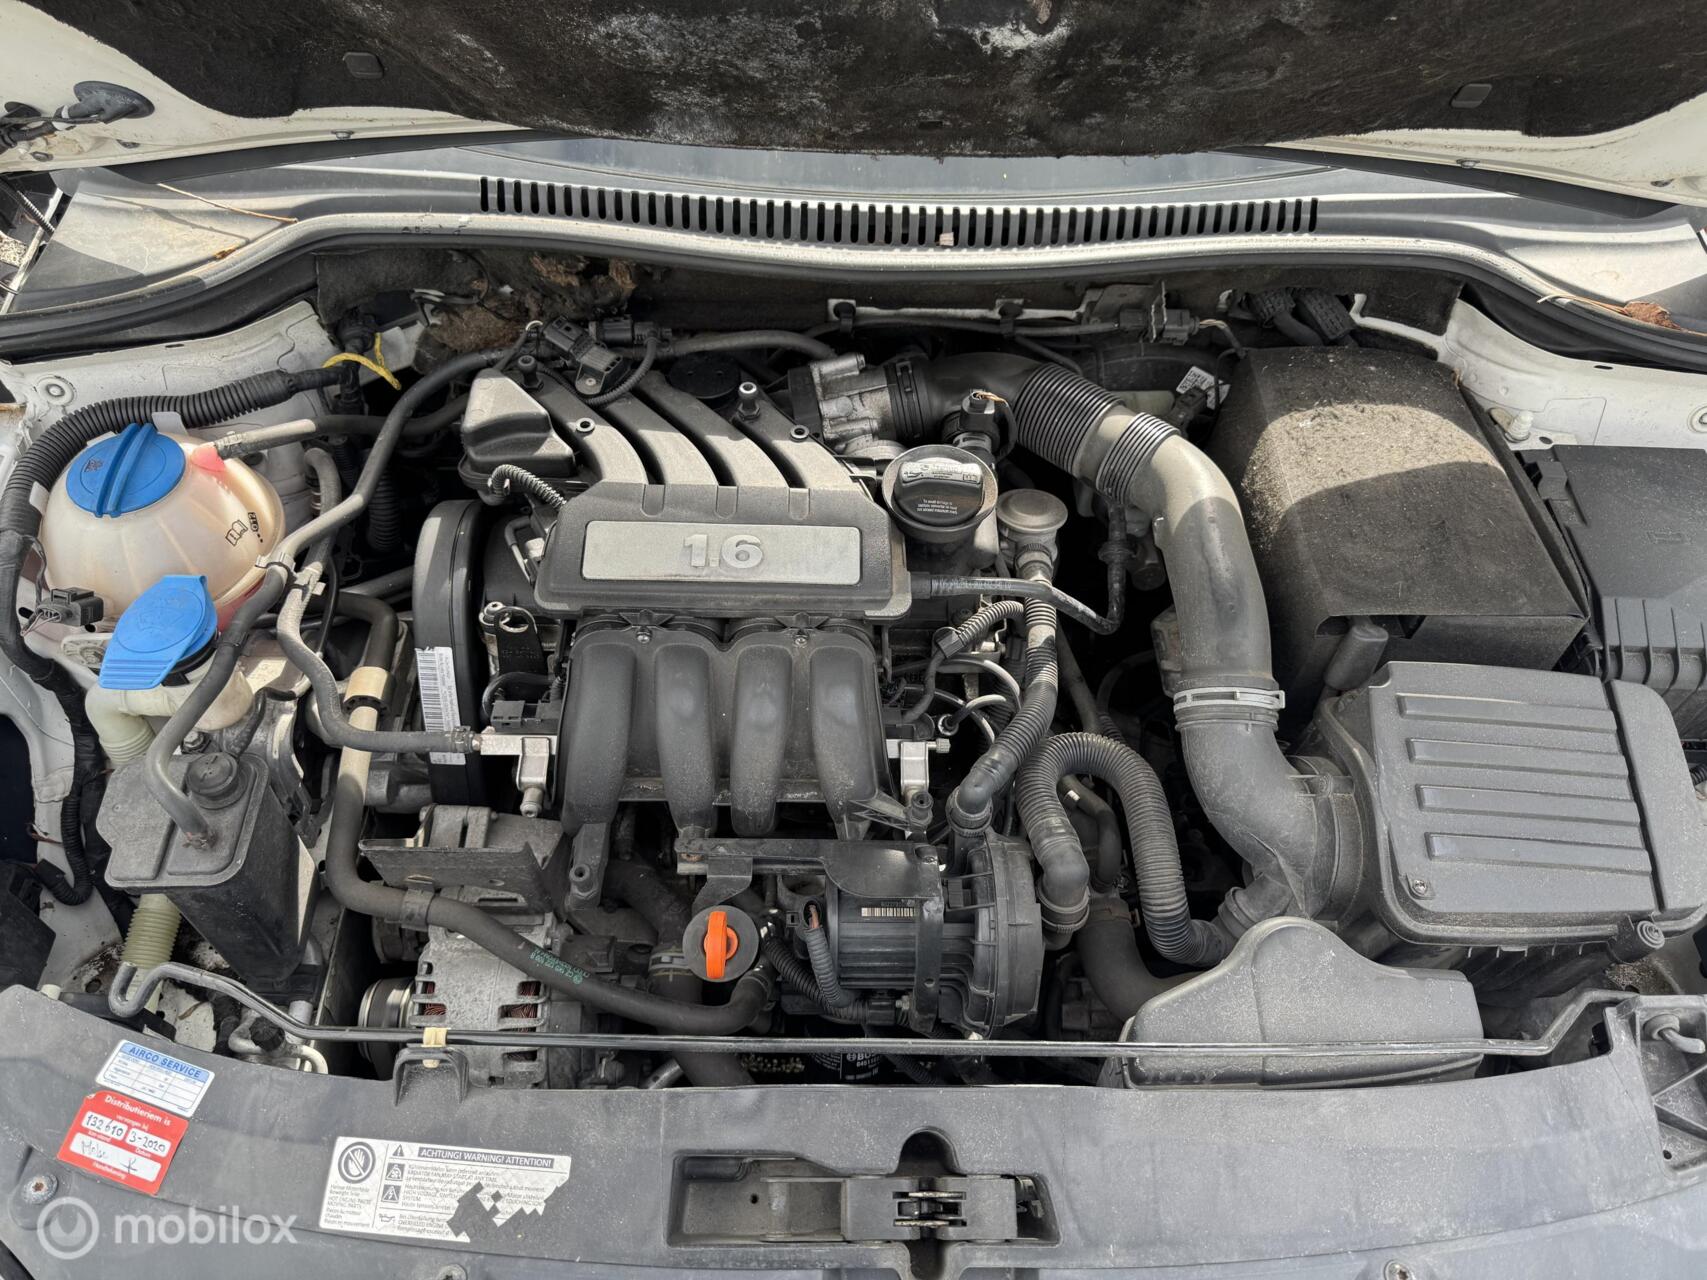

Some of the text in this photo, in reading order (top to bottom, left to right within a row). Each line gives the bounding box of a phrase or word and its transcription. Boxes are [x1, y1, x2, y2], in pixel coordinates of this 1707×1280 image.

[683, 534, 764, 569] 1.6
[129, 1046, 158, 1064] AIRCO
[161, 1057, 202, 1079] SERVICE
[105, 1095, 171, 1126] Distributieriem is
[420, 1149, 552, 1168] ACHTUNG! WARNING! ATTENTION!
